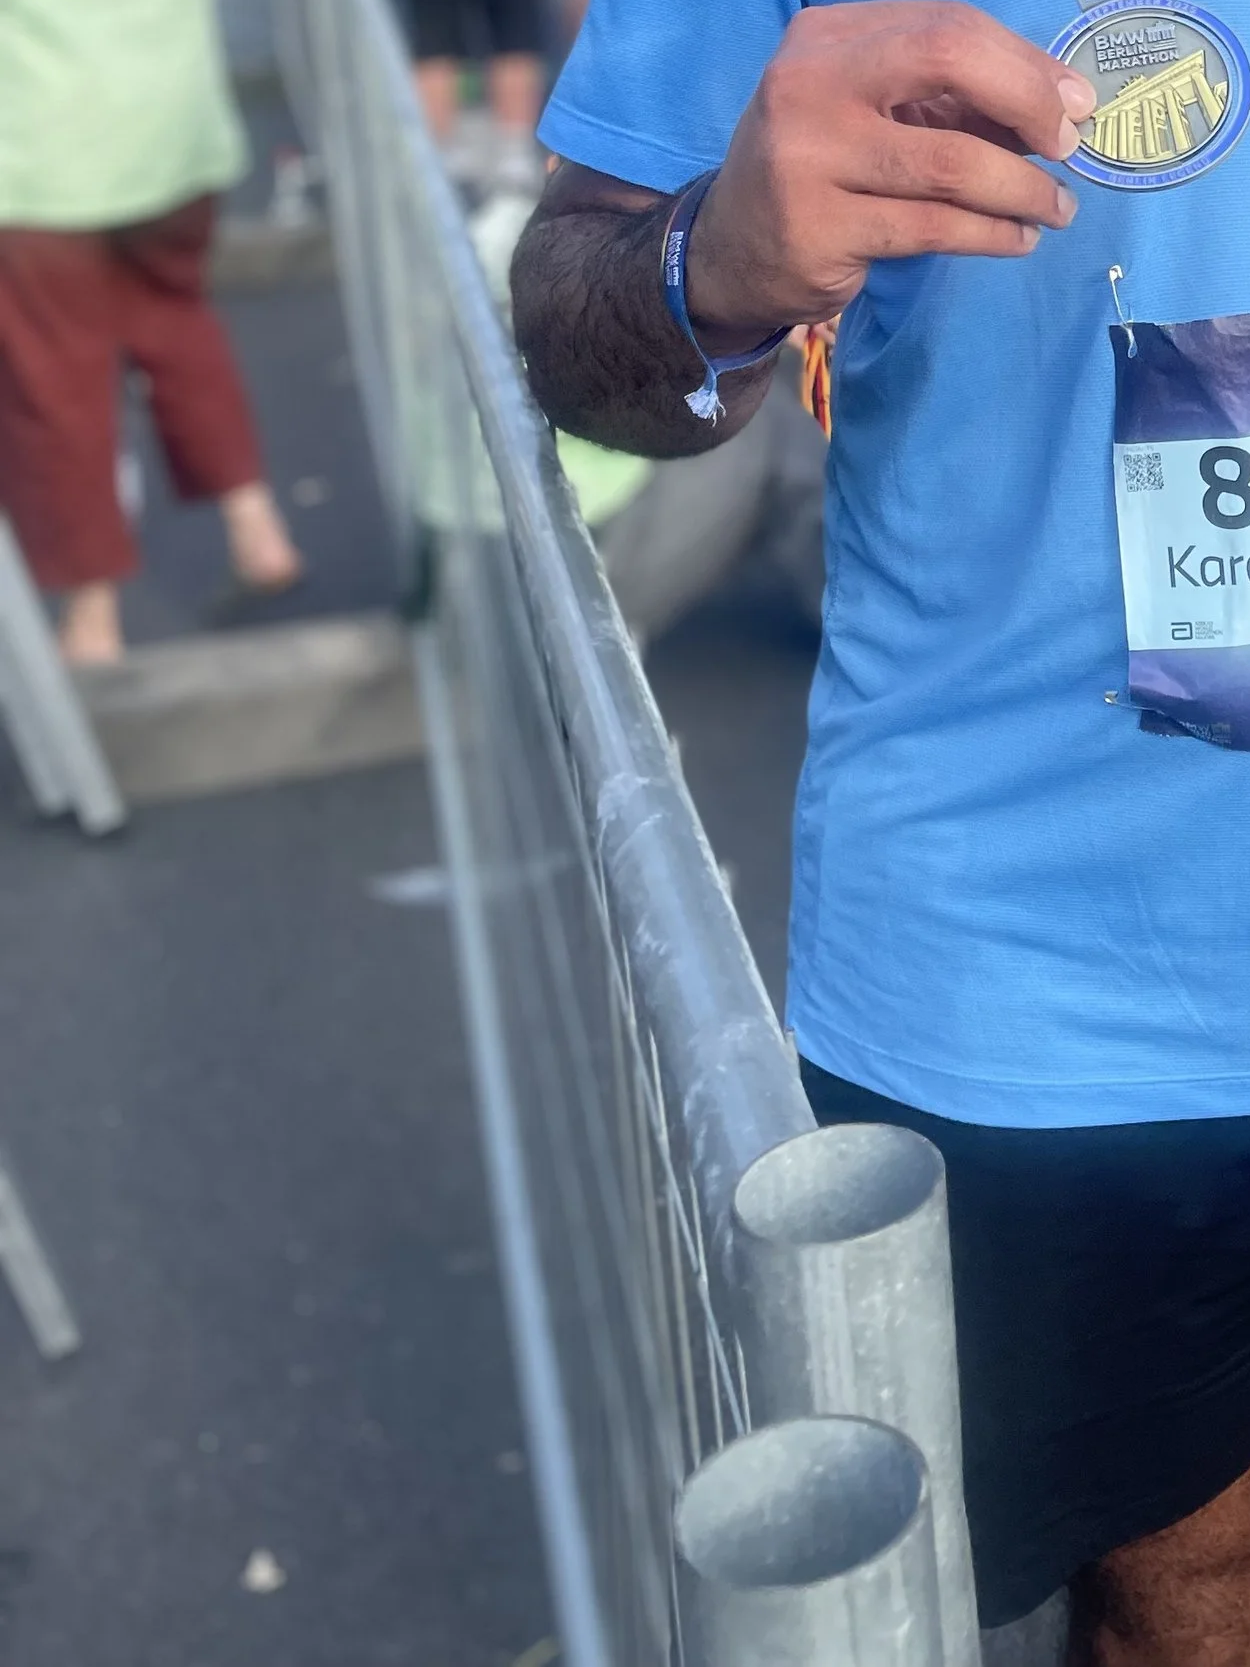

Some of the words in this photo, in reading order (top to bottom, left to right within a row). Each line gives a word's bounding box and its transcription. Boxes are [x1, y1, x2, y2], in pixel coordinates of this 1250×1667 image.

[1094, 28, 1146, 51] BMW
[1096, 44, 1149, 62] BERLIN
[1097, 49, 1180, 73] MARATHON
